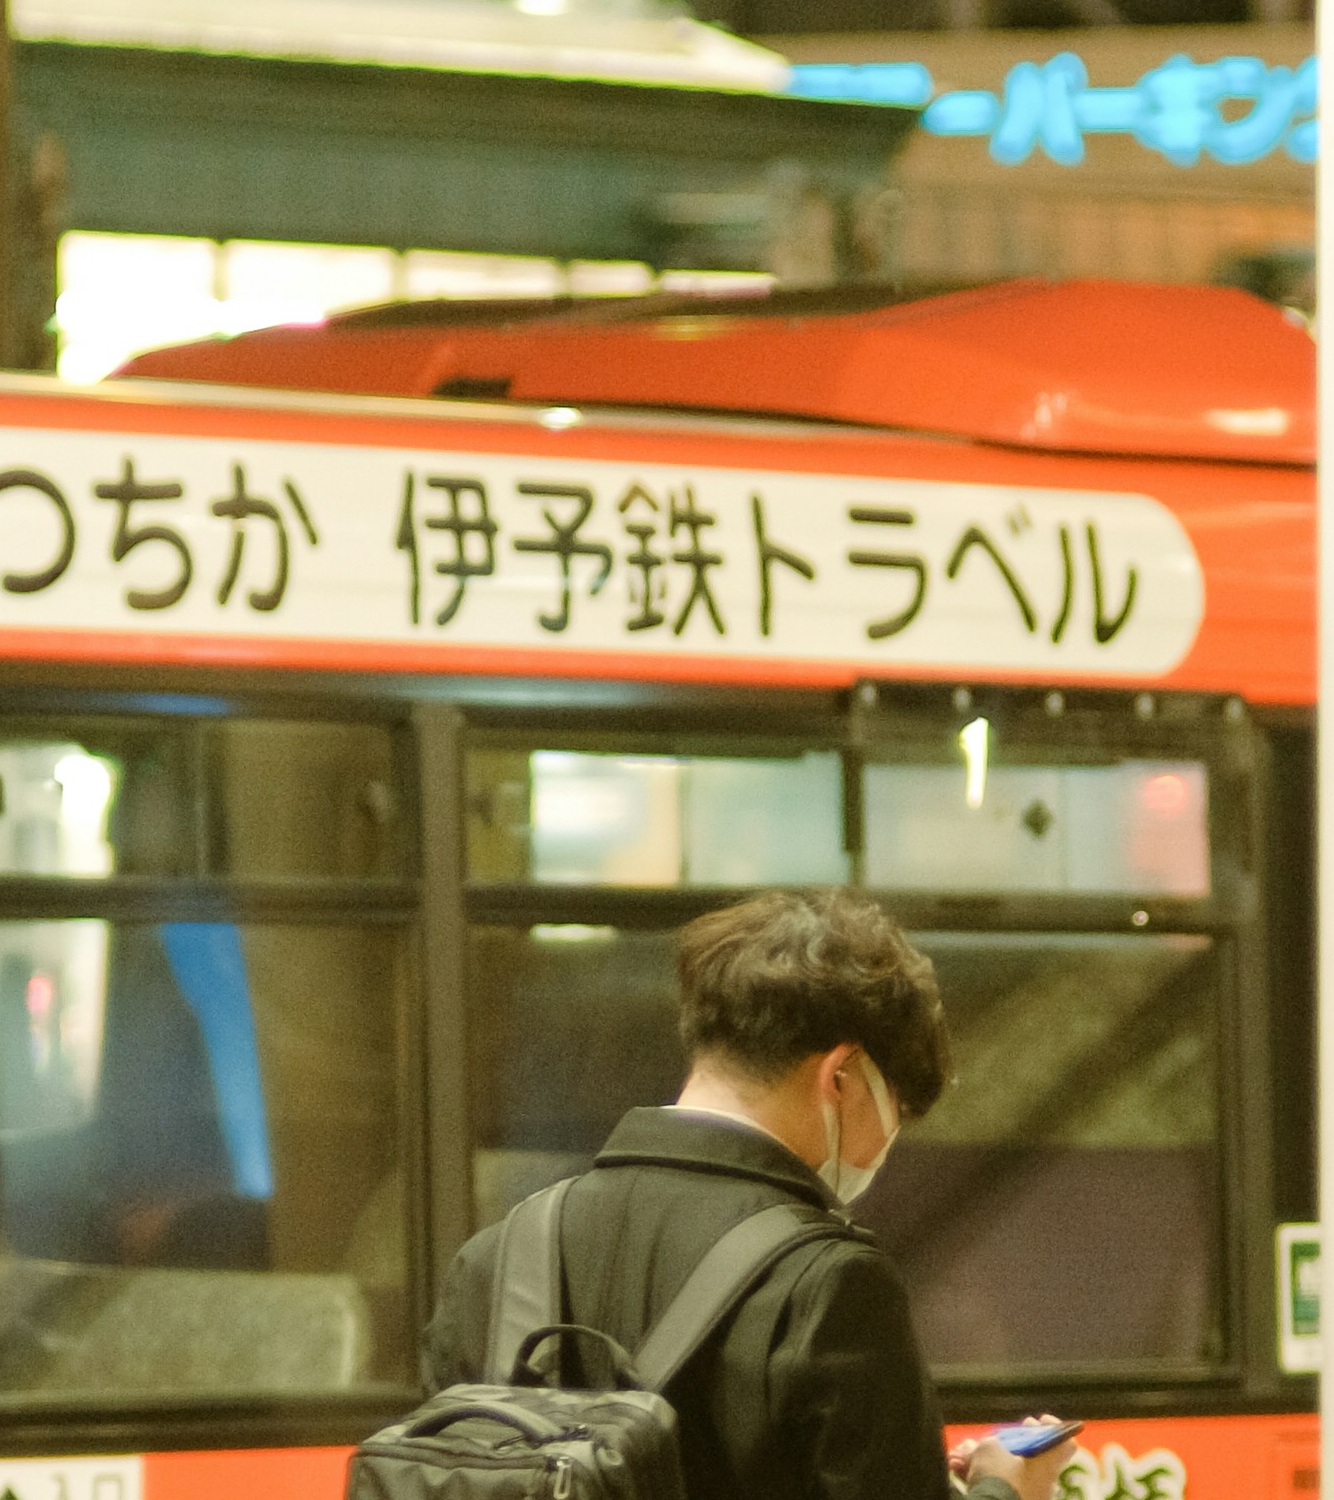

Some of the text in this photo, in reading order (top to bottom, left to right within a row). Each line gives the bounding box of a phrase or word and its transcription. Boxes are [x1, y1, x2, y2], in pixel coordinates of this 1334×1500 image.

[397, 466, 1140, 646] 伊予鉄トラベル
